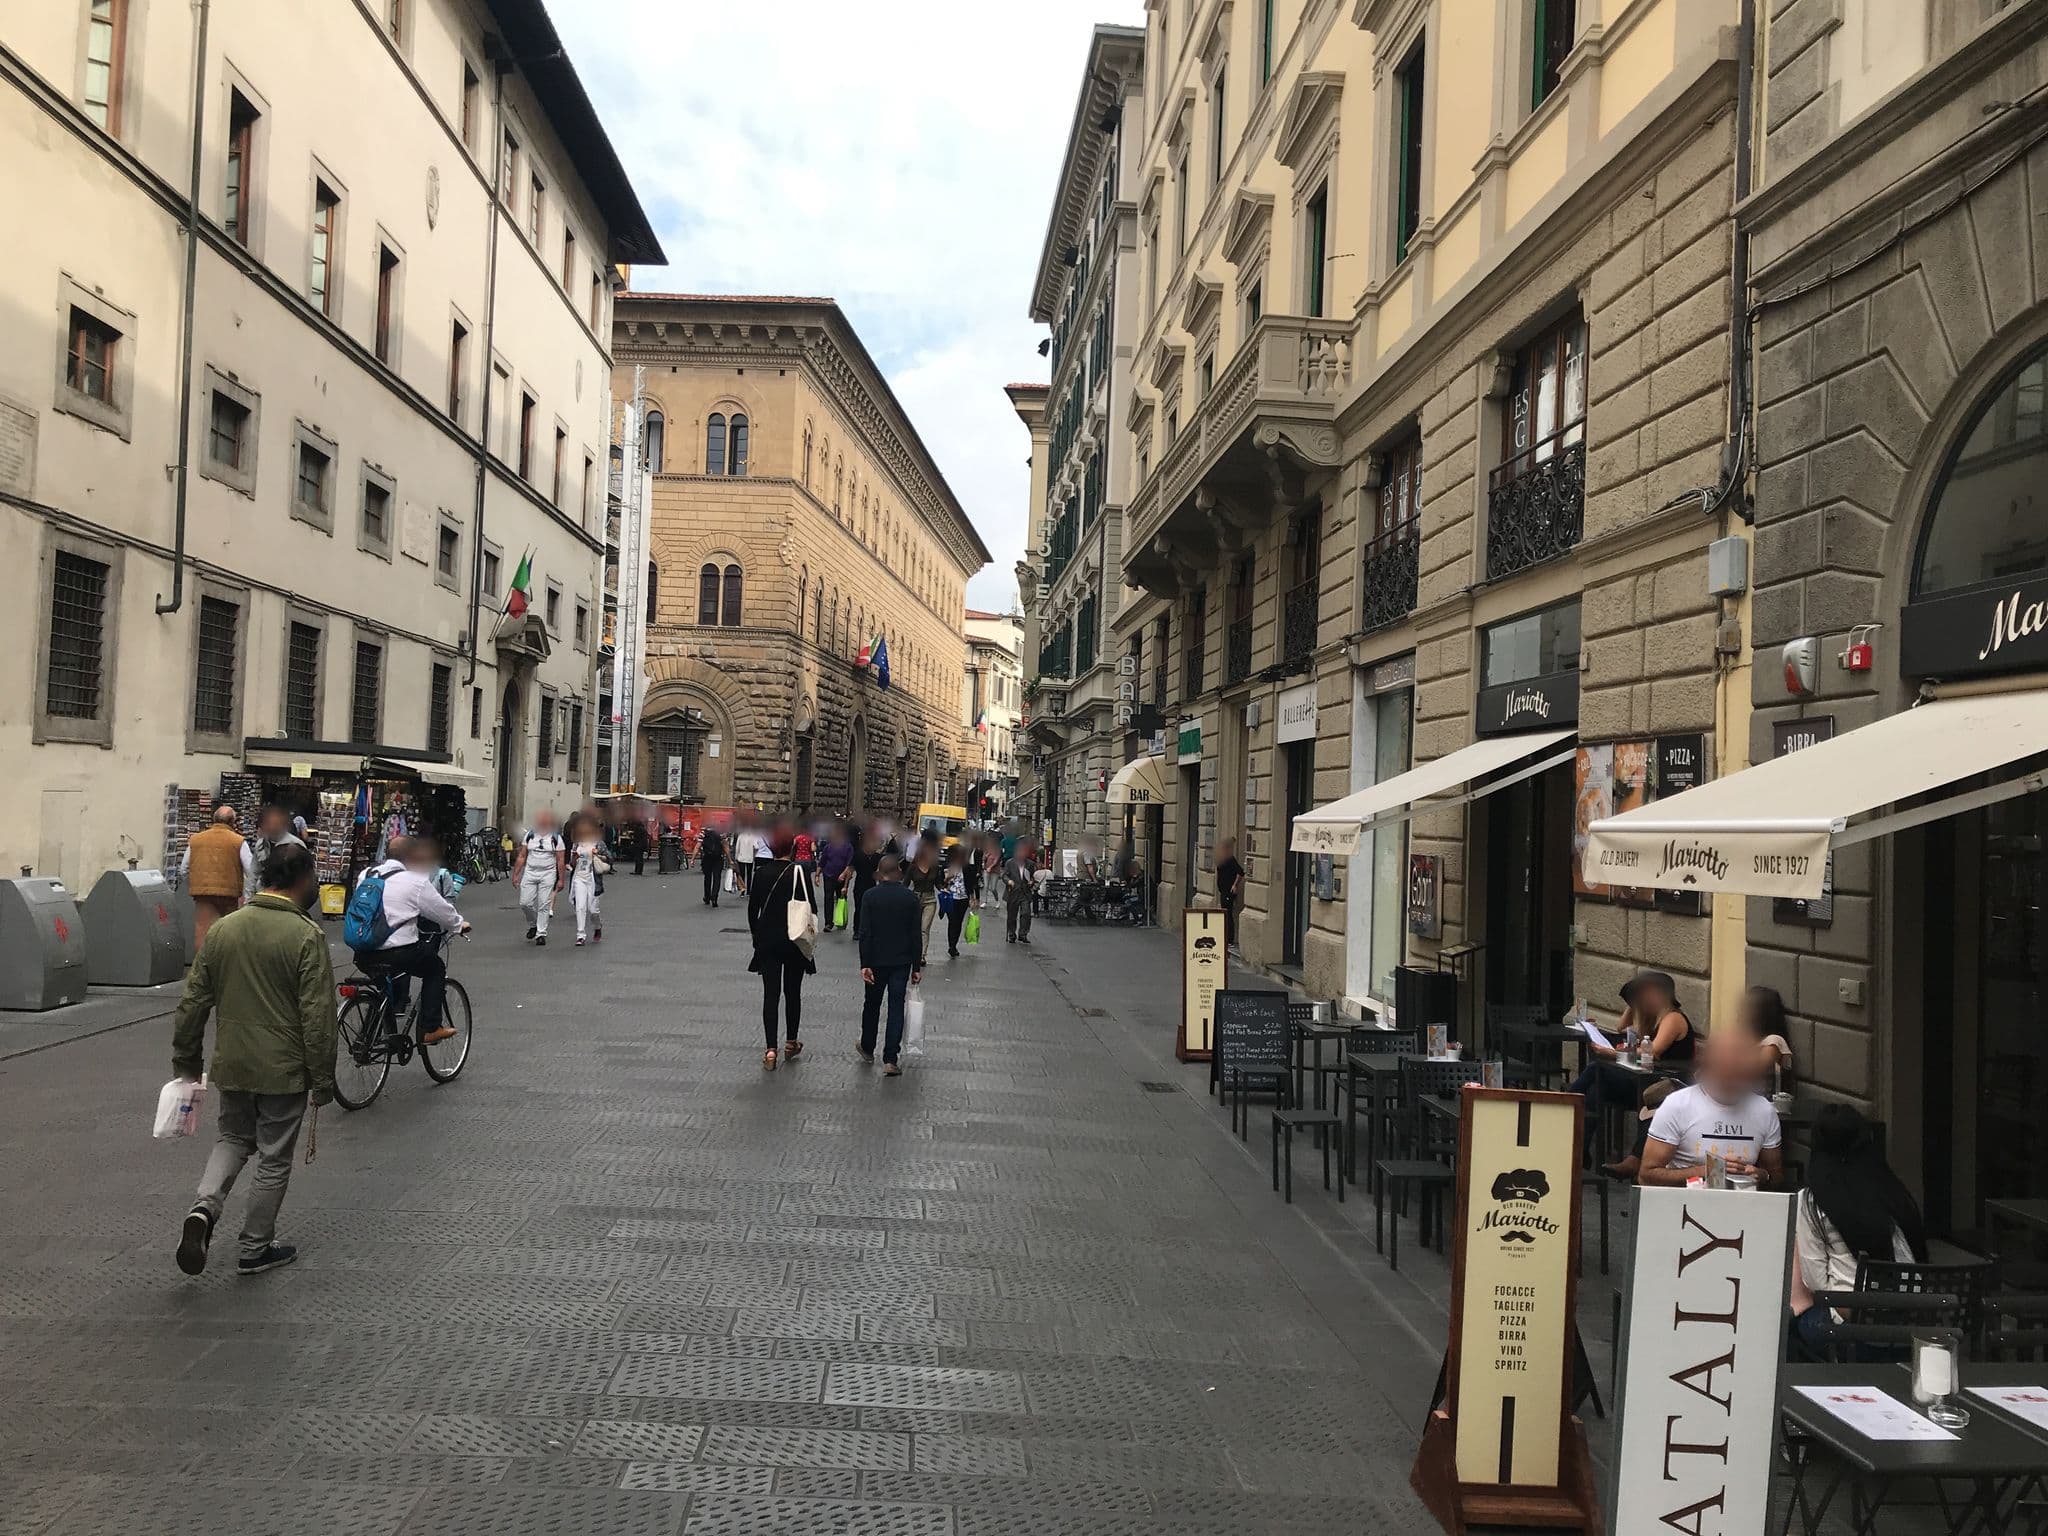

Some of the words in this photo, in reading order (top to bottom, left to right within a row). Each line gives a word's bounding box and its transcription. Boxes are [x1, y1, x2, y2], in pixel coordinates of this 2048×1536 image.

[1035, 520, 1052, 620] HOTEL
[1979, 591, 2048, 661] Ma
[1119, 655, 1136, 727] BAR
[1500, 687, 1551, 726] Mariotto
[1787, 733, 1816, 754] BIRRA
[1669, 748, 1691, 766] PIZZA
[1130, 788, 1150, 801] BAR
[1600, 850, 1614, 864] OLD
[1615, 851, 1639, 868] BAKERY
[1656, 839, 1729, 881] Mariotto
[1753, 855, 1782, 875] SINCE
[1786, 856, 1809, 876] 1927
[1476, 1209, 1560, 1235] Mariotto
[1495, 1286, 1535, 1297] FOCACCE
[1494, 1300, 1535, 1312] TAGLIERI
[1500, 1316, 1526, 1326] PIZZA
[1499, 1331, 1526, 1341] BIRRA
[1501, 1345, 1523, 1356] VINO
[1495, 1360, 1527, 1371] SPRITZ
